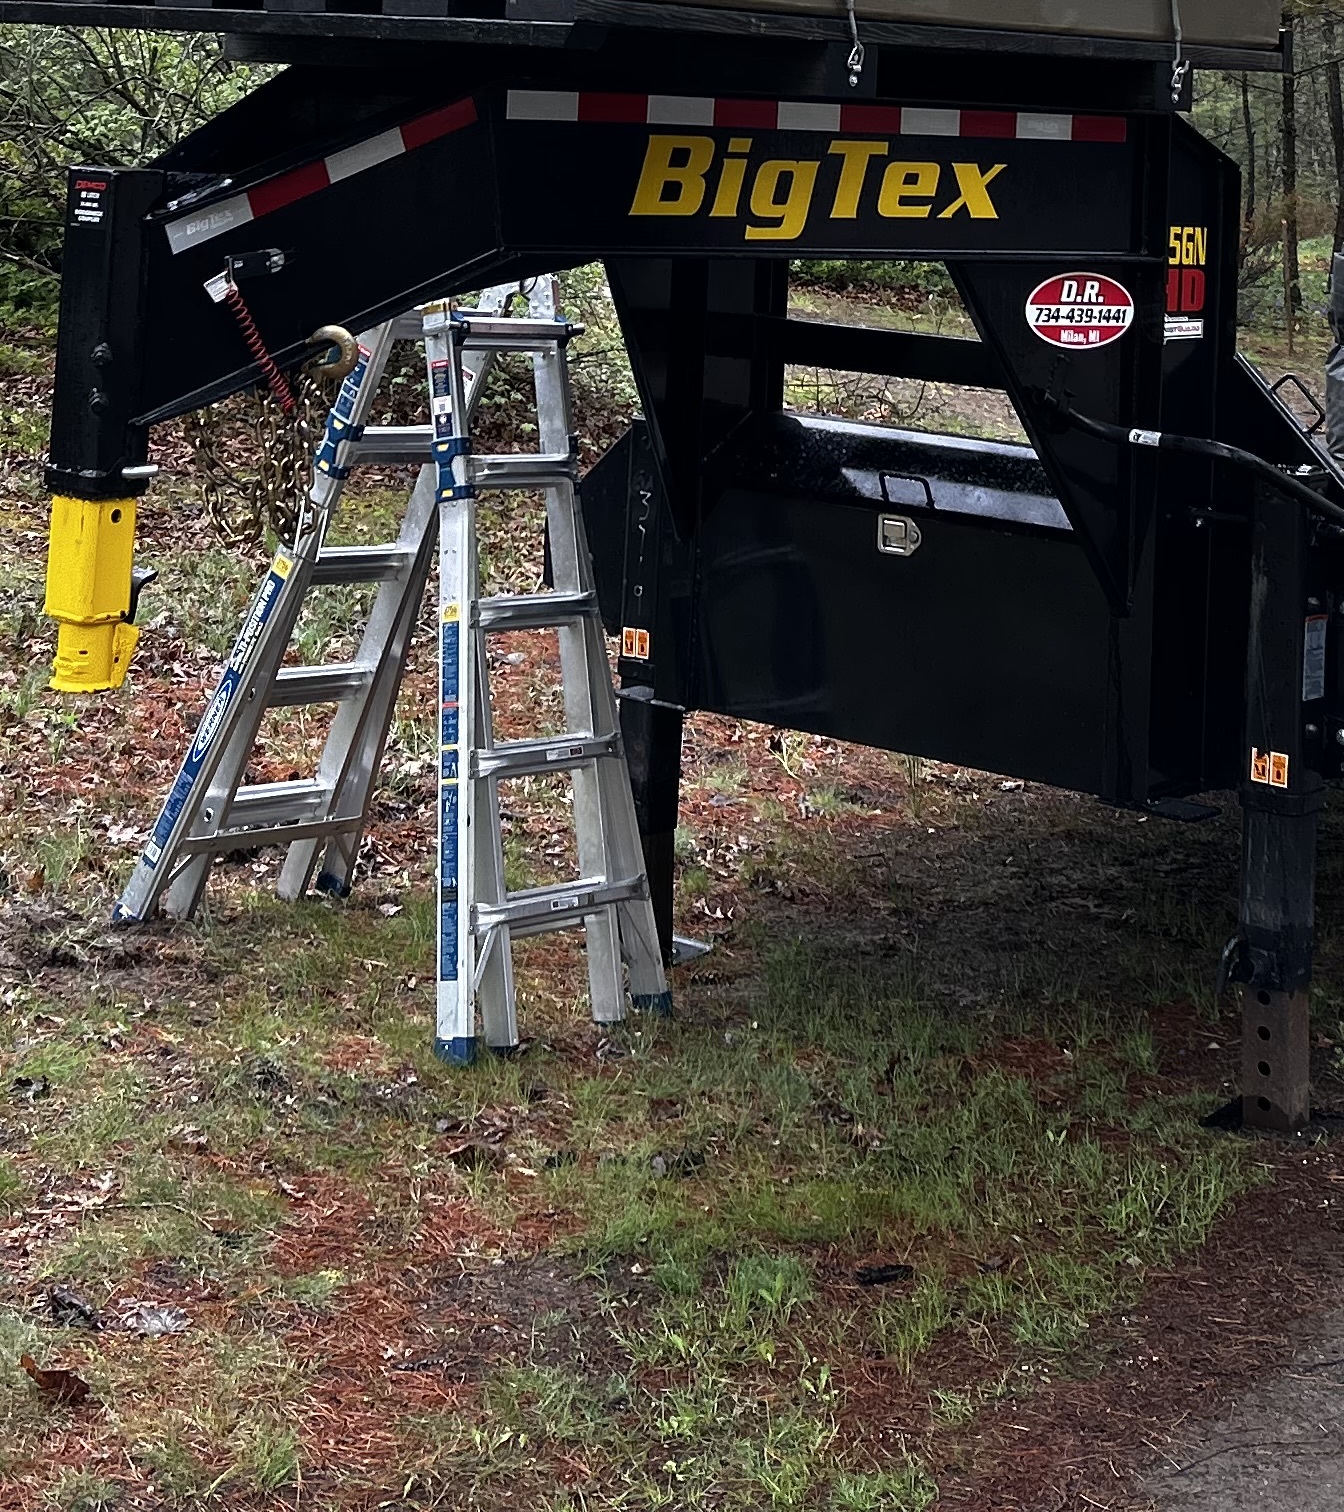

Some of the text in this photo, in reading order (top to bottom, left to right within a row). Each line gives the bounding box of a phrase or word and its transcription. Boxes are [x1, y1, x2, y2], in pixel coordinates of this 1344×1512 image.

[628, 134, 1008, 240] BigTex
[1060, 280, 1104, 303] D.R.
[1034, 307, 1127, 324] 734-439-1441
[1060, 329, 1100, 345] Milan, MI
